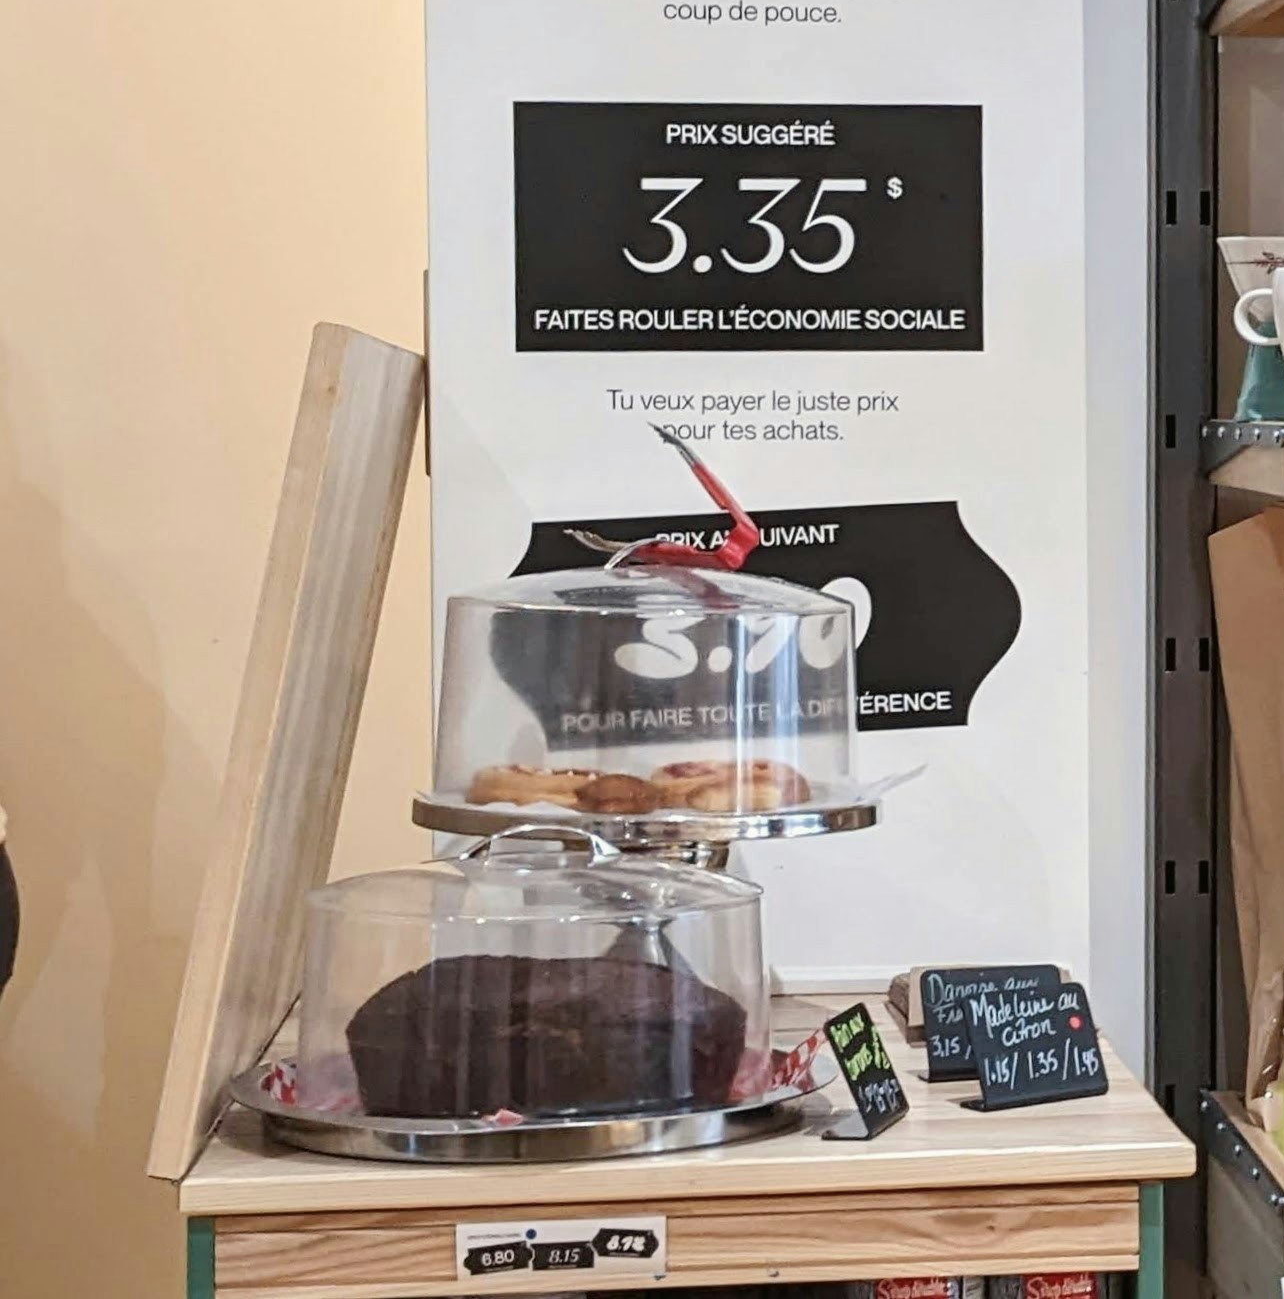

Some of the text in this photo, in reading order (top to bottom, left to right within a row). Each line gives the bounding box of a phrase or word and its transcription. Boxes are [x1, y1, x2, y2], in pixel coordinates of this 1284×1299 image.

[662, 0, 843, 27] coup de pouce.
[666, 119, 836, 146] PRIX SUGGÉRÉ
[622, 176, 868, 274] 3.35
[534, 303, 966, 332] FAITES ROULER L'ÉCONOMIE SOCIALE
[606, 390, 899, 418] Tu veux payer le juste prix
[662, 420, 844, 444] pour tes achats.
[561, 710, 625, 734] POUR
[629, 703, 693, 730] FAIRE
[969, 992, 1080, 1038] Madeleine au
[481, 1248, 580, 1267] 6.80 8.15
